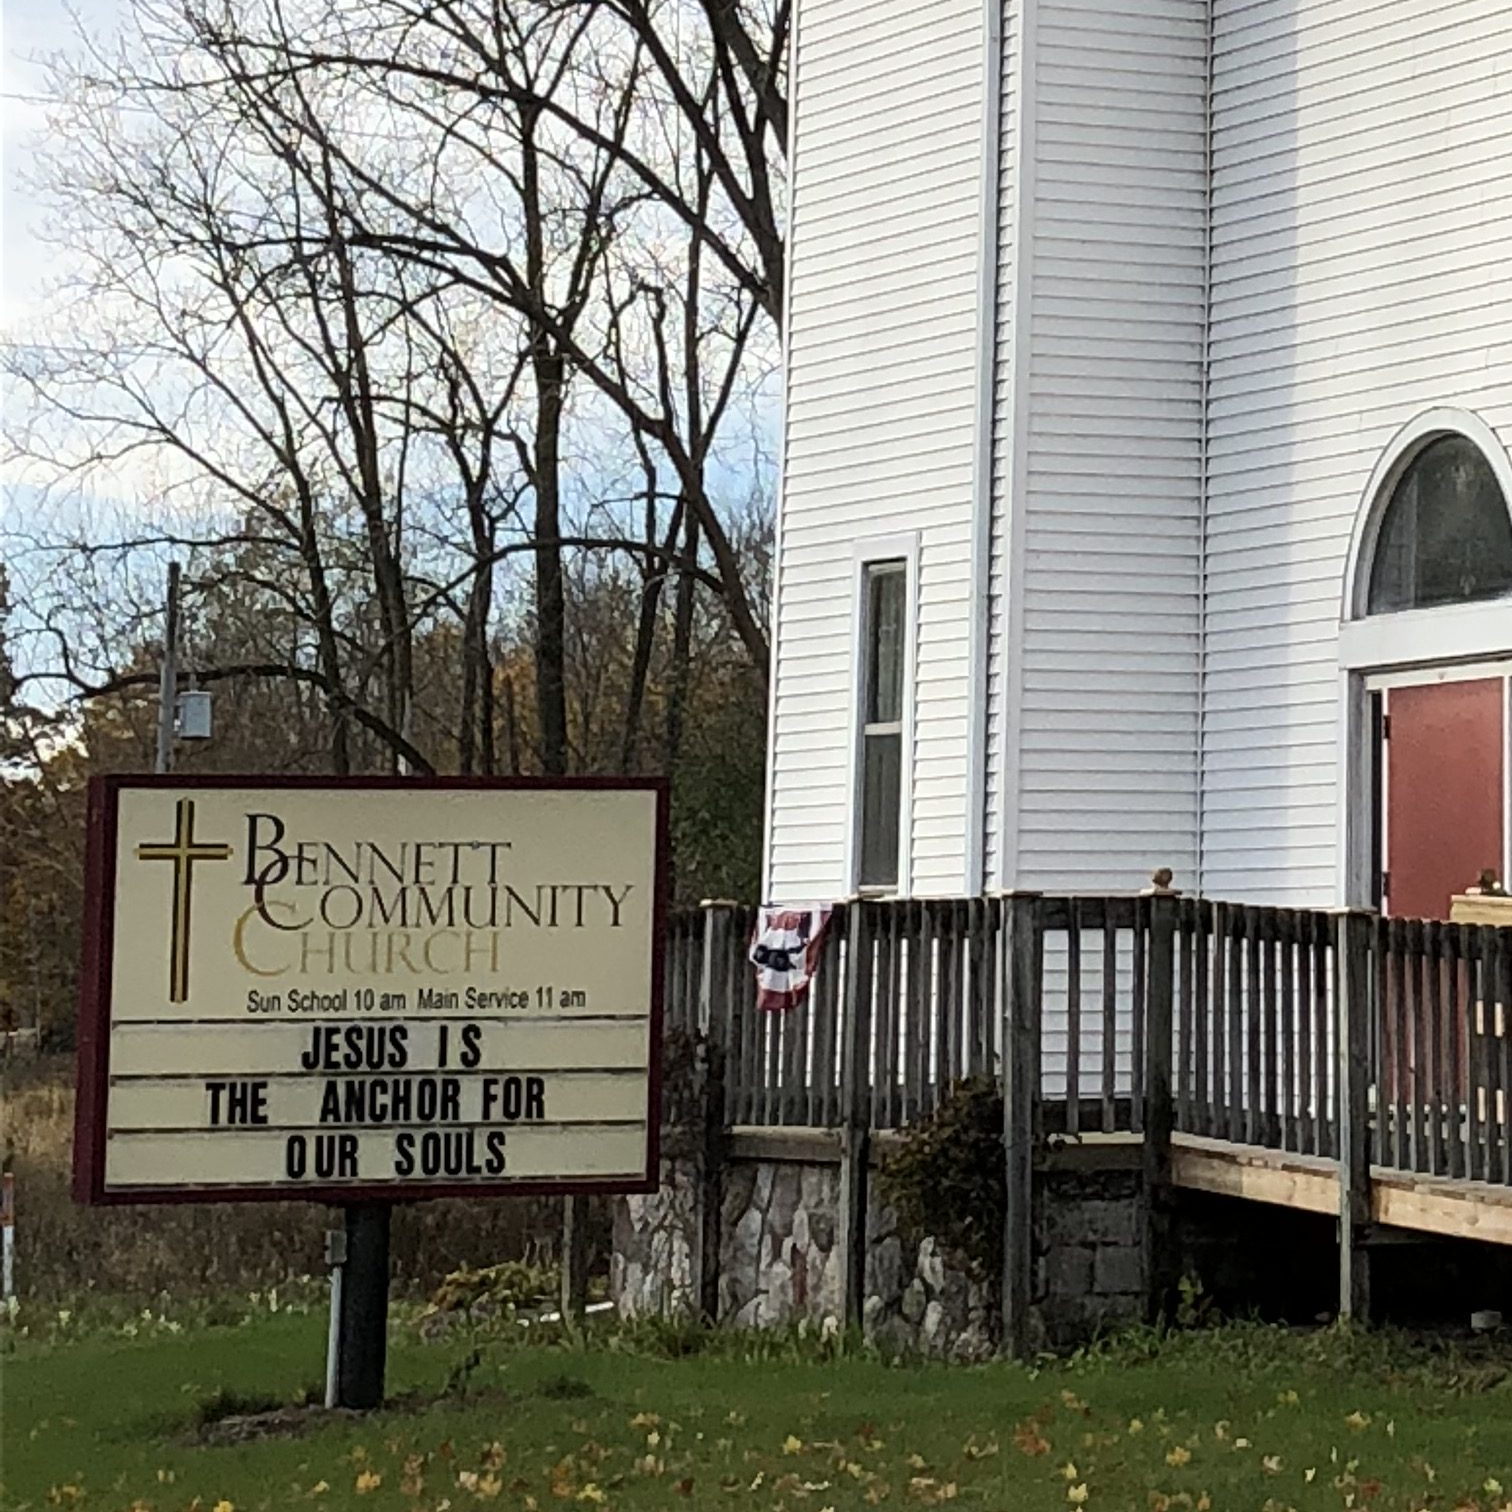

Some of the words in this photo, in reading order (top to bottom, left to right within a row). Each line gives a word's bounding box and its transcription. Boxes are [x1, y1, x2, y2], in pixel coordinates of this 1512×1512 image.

[240, 813, 512, 887] BENNETT
[254, 851, 635, 931] COMMUNITY
[233, 900, 501, 976] CHURCH
[247, 990, 283, 1012] Sun
[287, 990, 348, 1012] School
[354, 990, 375, 1011] 10
[380, 993, 406, 1011] am
[417, 989, 461, 1010] Main
[465, 988, 530, 1009] Service
[535, 988, 555, 1008] 11
[559, 991, 586, 1008] am
[301, 1025, 408, 1069] JESUS
[438, 1024, 481, 1068] IS
[206, 1082, 268, 1125] THE
[319, 1079, 461, 1123] ANCHOR
[482, 1077, 545, 1120] FOR
[286, 1136, 358, 1179] OUR
[395, 1132, 506, 1177] SOULS
